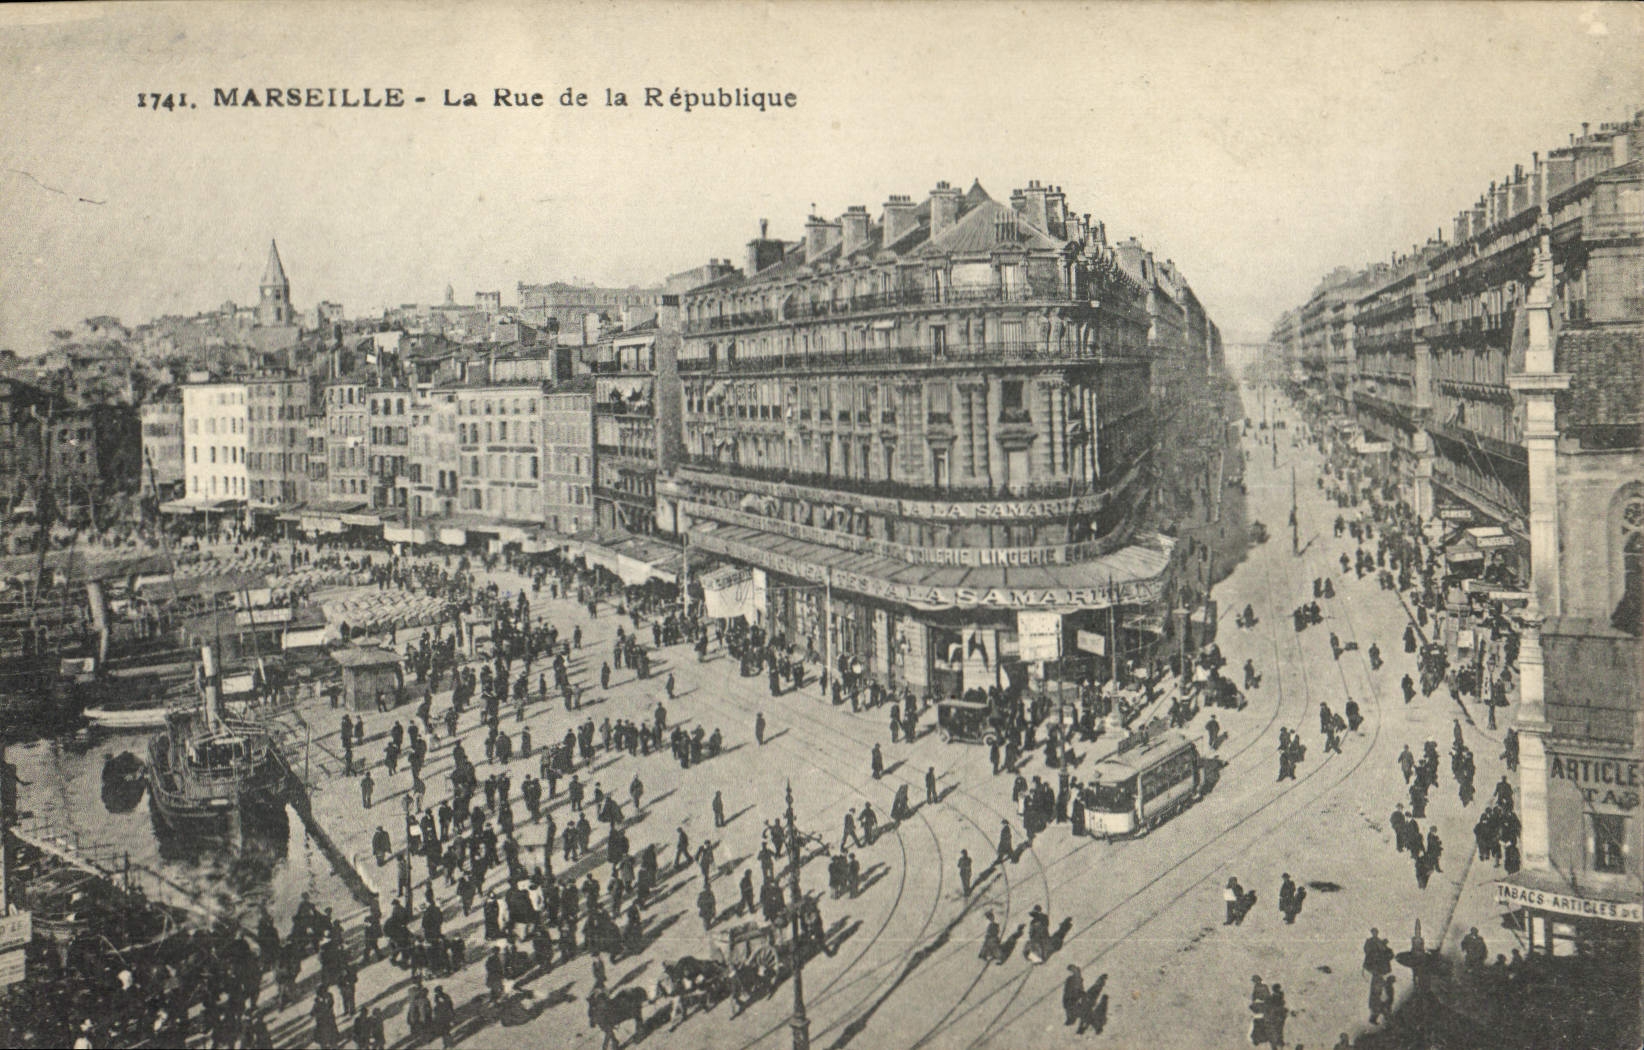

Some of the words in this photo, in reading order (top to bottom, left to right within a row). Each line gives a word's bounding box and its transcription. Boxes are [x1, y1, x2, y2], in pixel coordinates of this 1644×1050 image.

[975, 497, 1101, 517] SAMARITA
[1498, 885, 1544, 905] TABACS
[1553, 897, 1617, 916] ARTICLES
